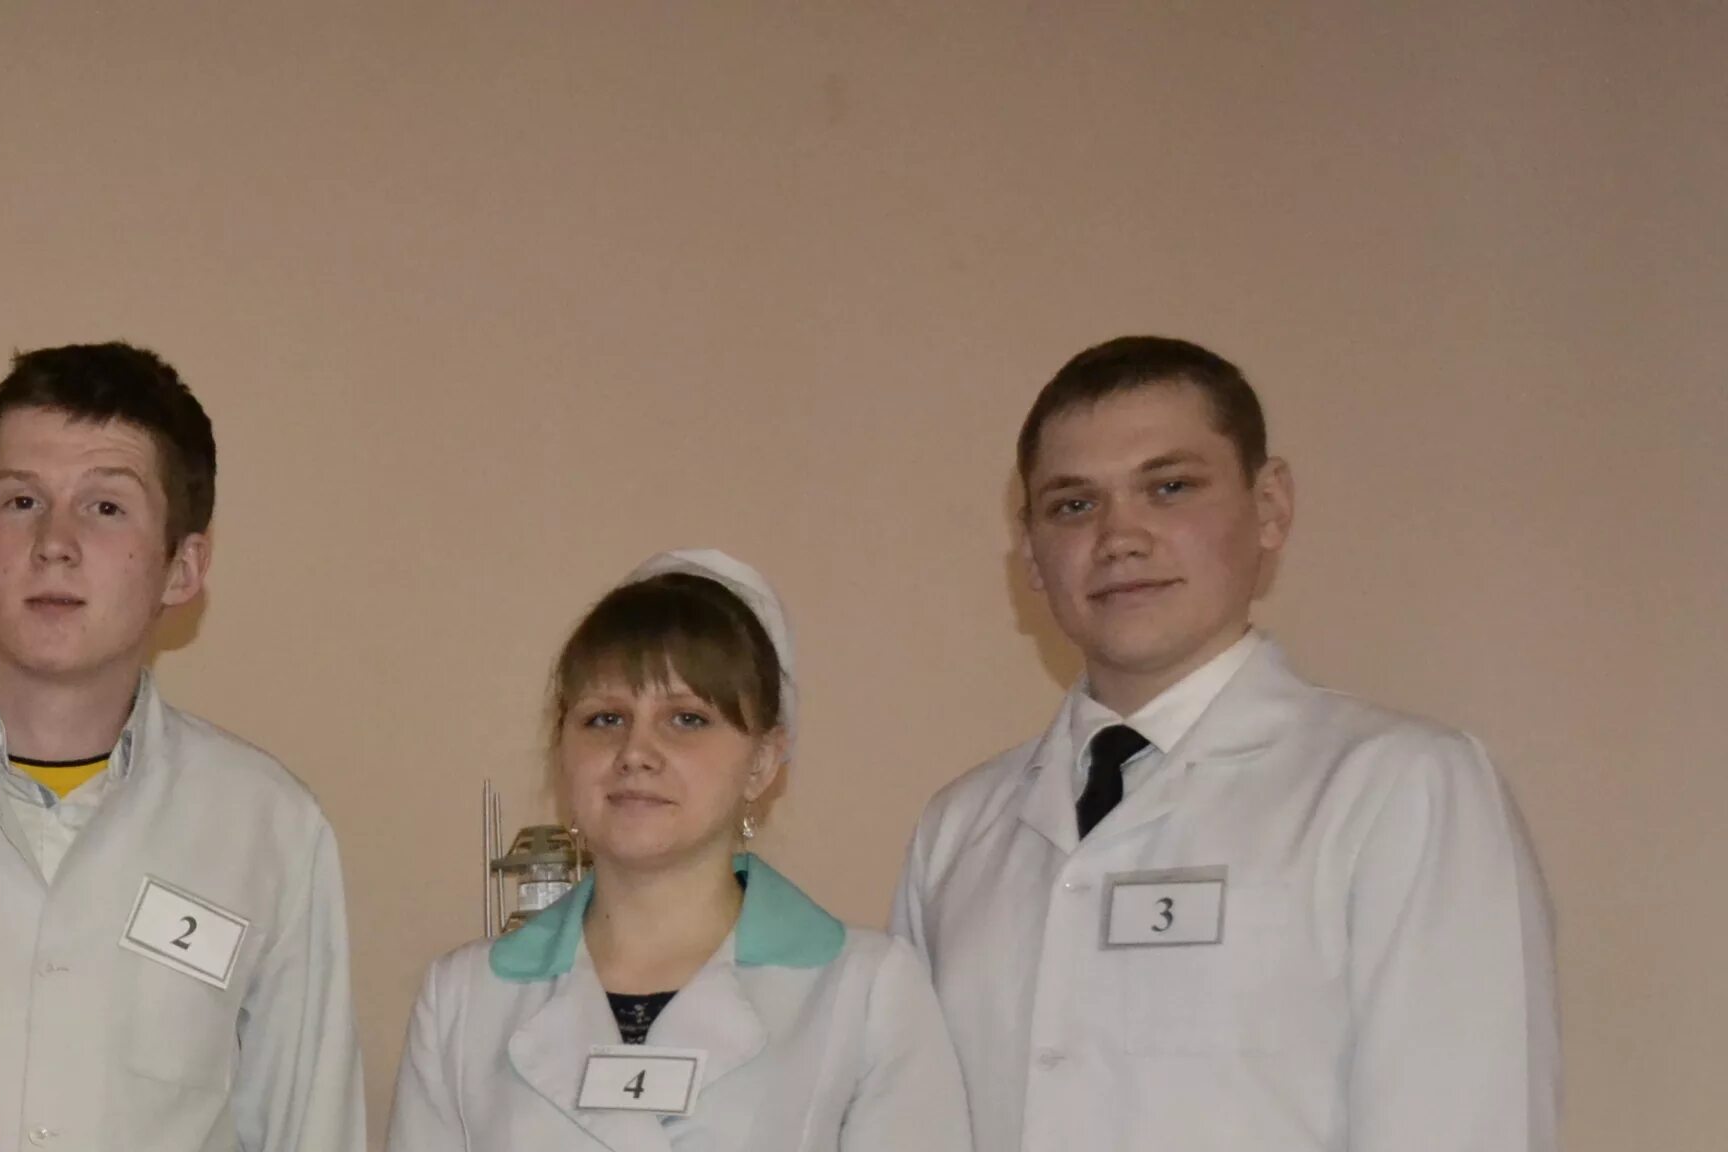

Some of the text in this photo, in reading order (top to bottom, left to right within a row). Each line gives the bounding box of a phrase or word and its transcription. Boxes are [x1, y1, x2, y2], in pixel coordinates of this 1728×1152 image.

[1151, 897, 1174, 932] 3
[170, 916, 198, 950] 2
[623, 1069, 646, 1099] 4
